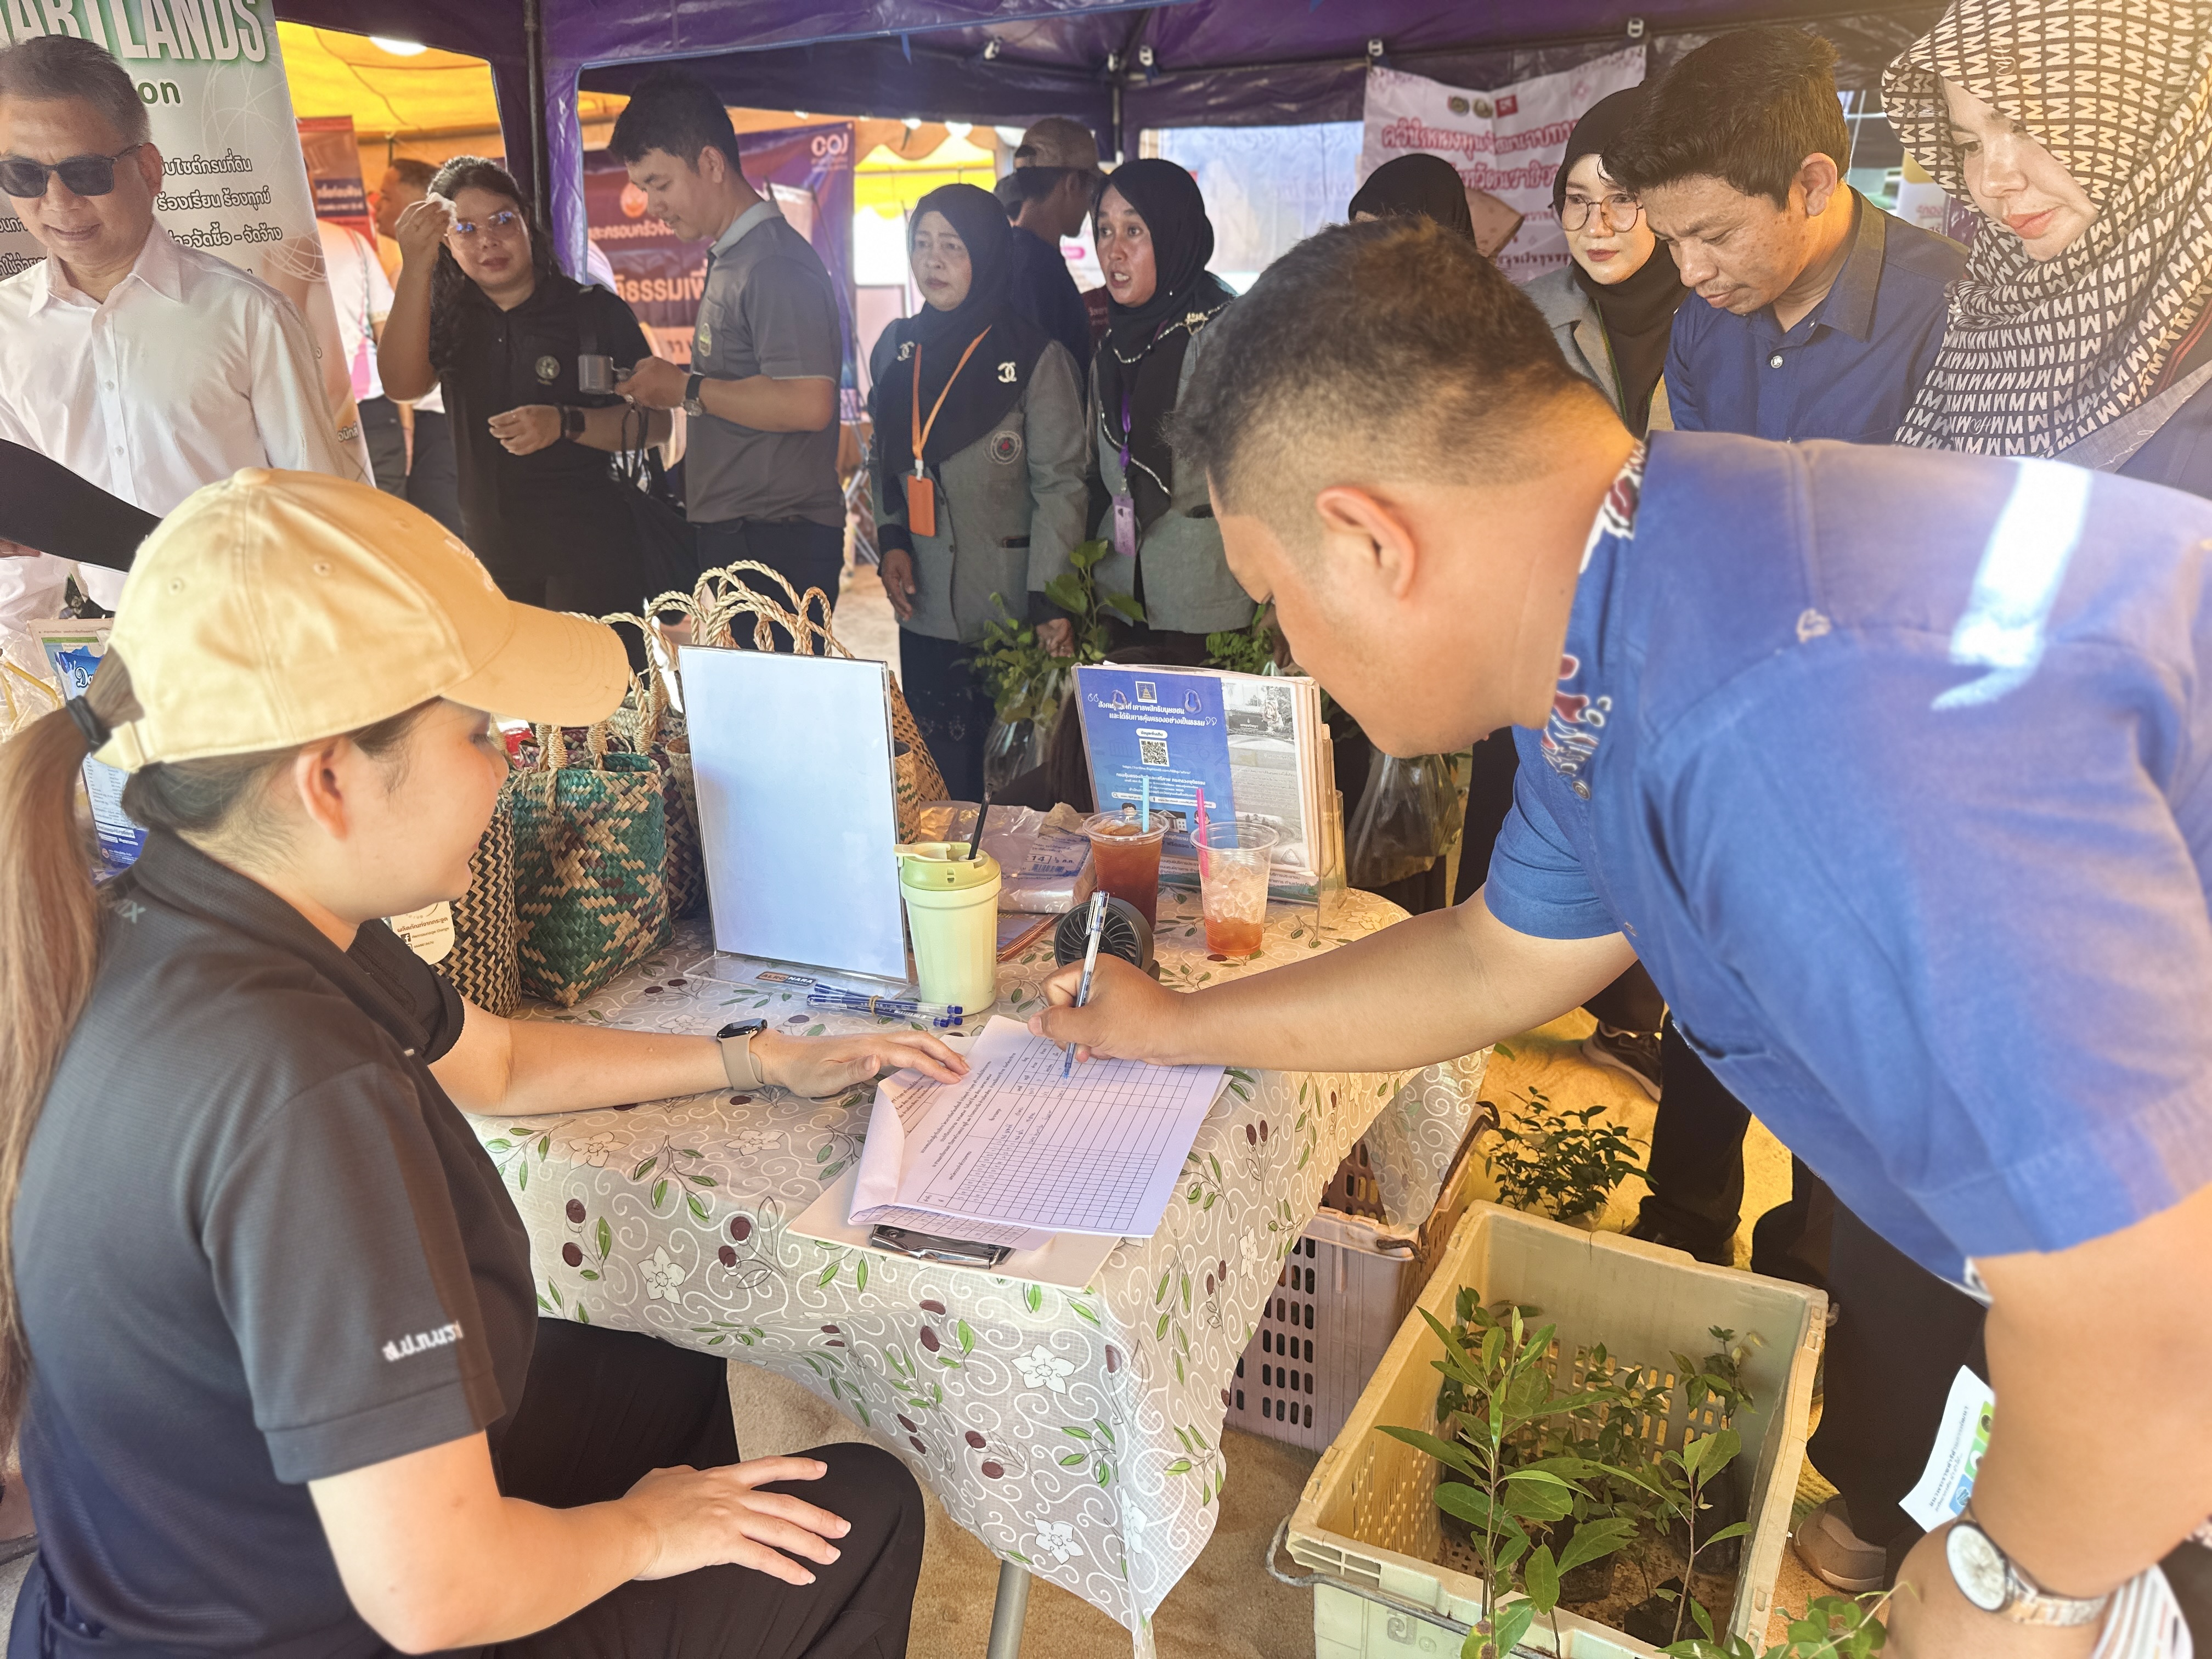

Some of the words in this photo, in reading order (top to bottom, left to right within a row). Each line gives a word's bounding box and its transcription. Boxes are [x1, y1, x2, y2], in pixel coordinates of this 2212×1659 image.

[222, 184, 271, 211] ร้องทุกข์
[243, 222, 283, 244] จัดจ้าง
